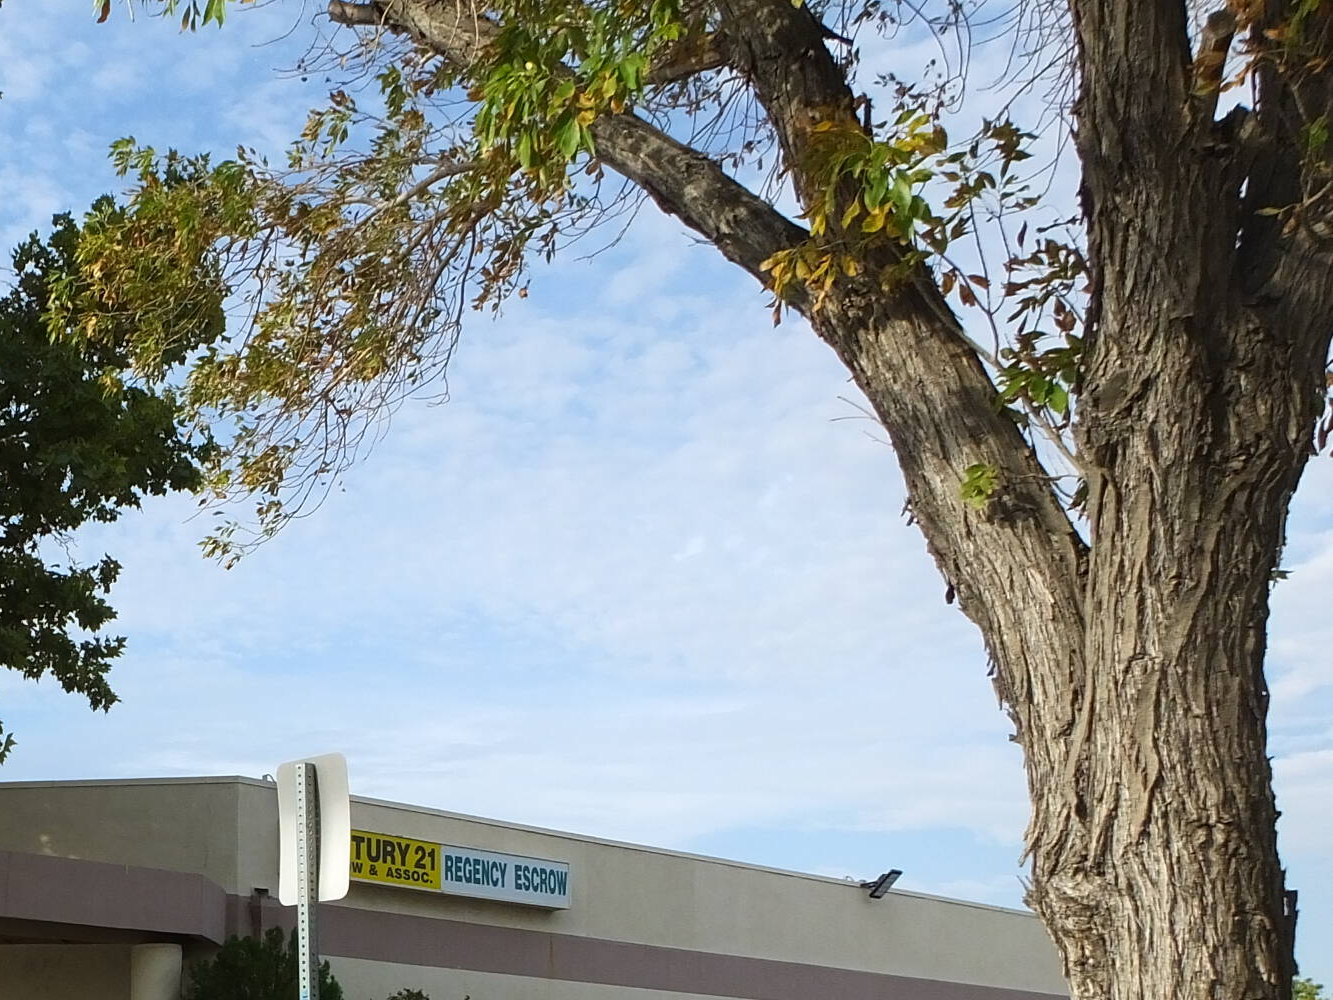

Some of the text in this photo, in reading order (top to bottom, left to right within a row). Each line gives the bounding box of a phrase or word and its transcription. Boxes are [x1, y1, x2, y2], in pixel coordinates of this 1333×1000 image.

[415, 845, 435, 871] 21
[369, 864, 378, 876] &
[386, 867, 433, 884] ASSOC.
[444, 854, 568, 896] REGENCY ESCROW
